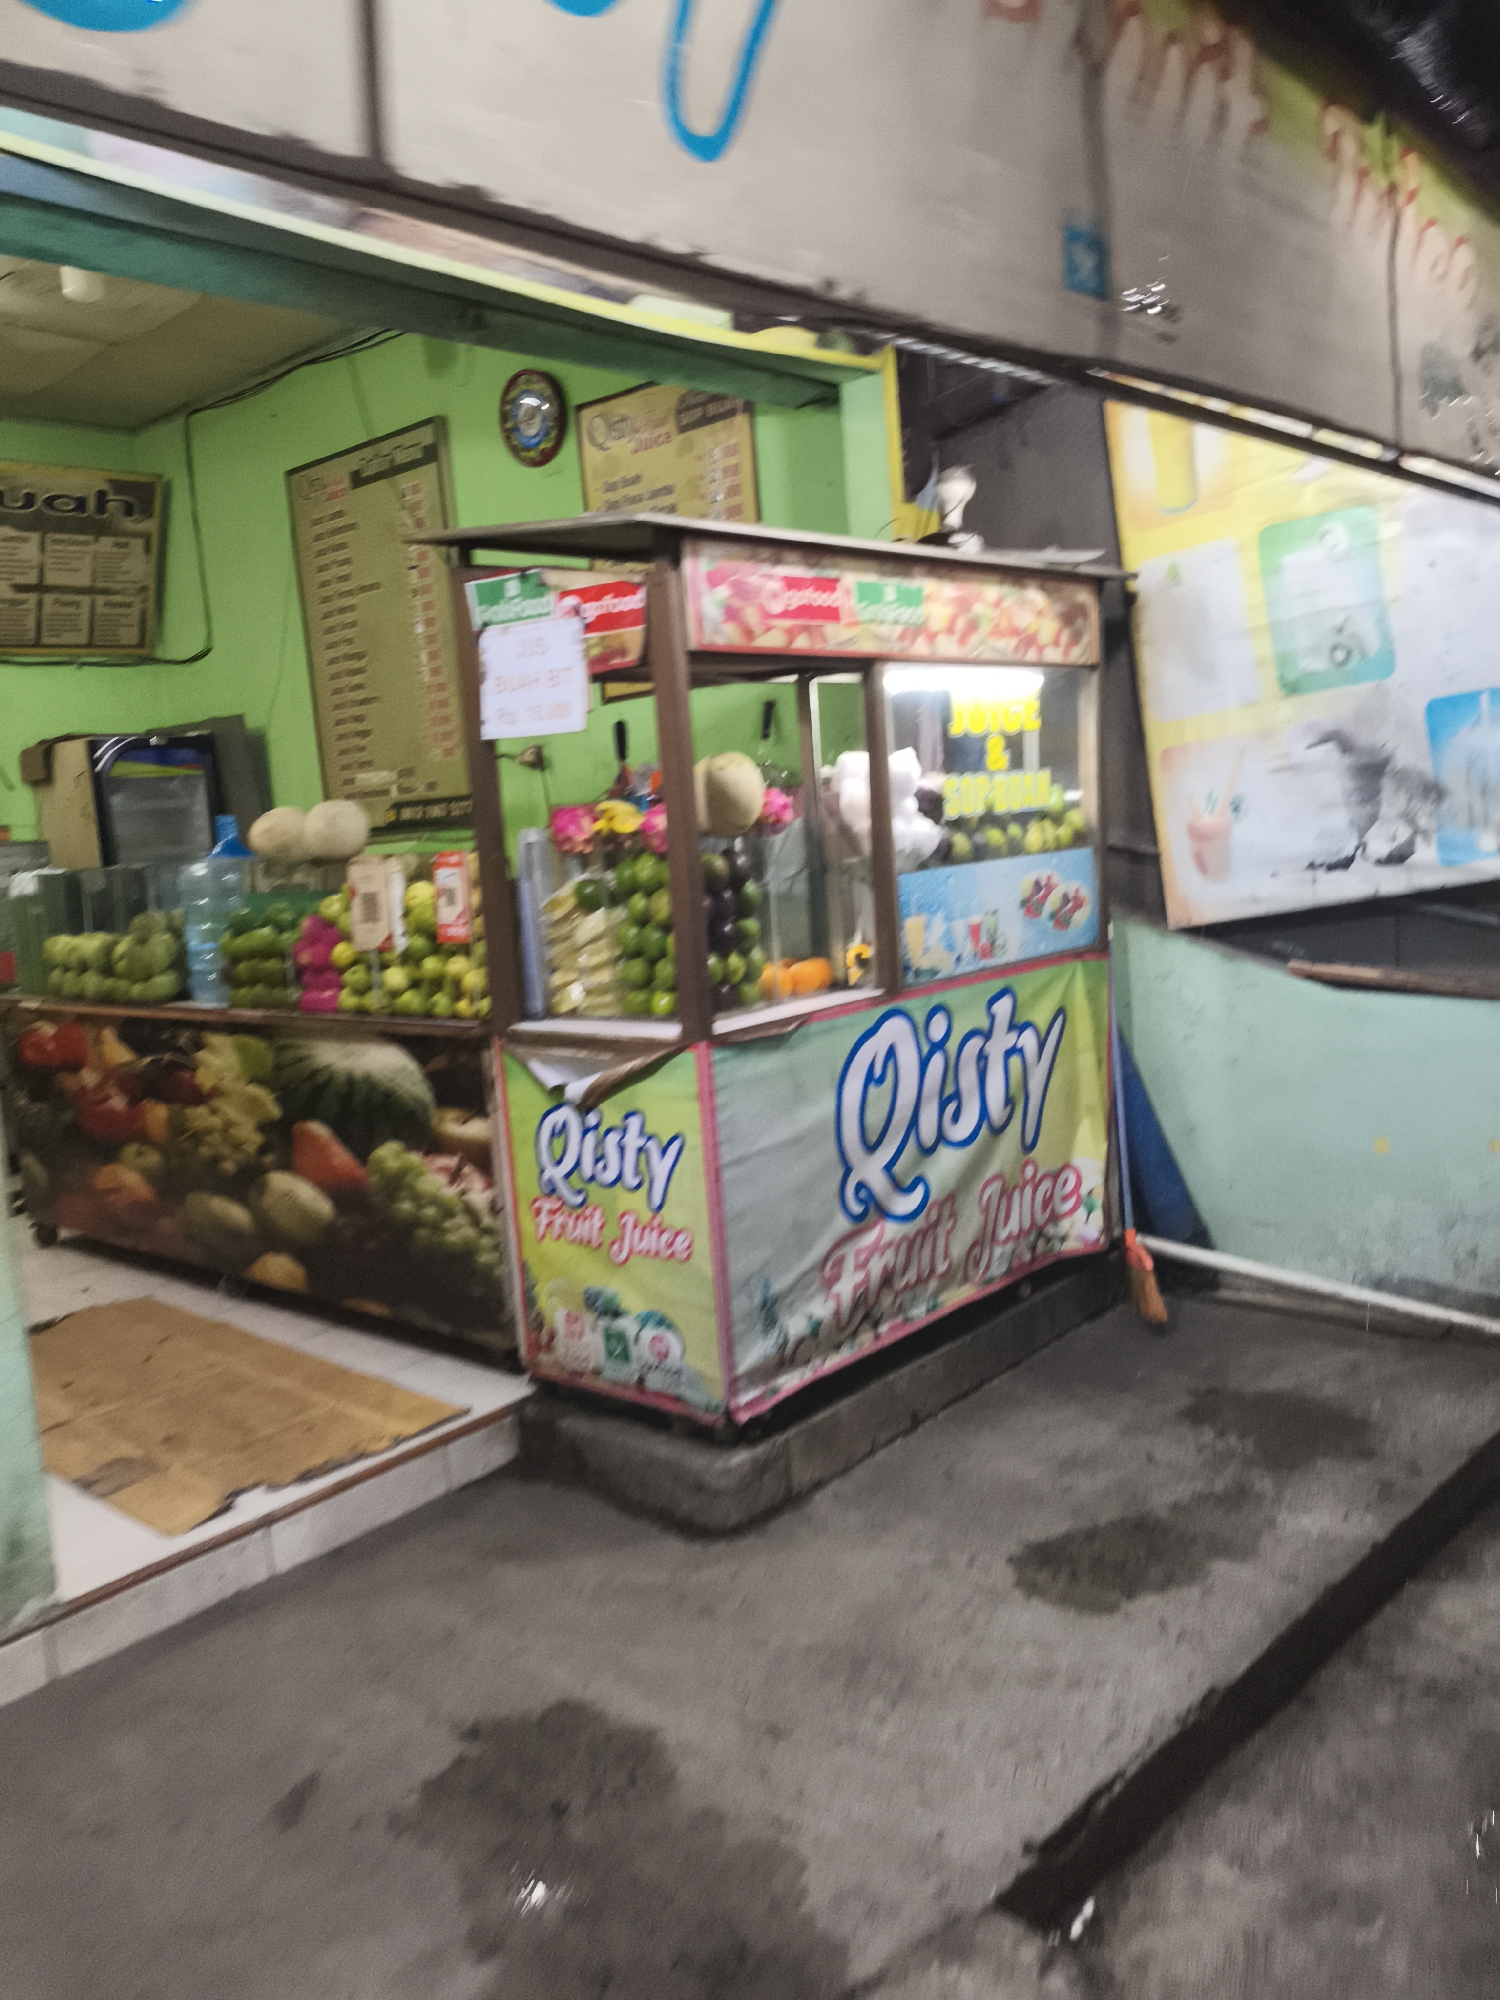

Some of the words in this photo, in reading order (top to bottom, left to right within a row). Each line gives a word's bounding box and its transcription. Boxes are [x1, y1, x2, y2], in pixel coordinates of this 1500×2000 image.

[948, 690, 1042, 737] JUICE
[984, 733, 1011, 772] &
[943, 772, 988, 821] SOP
[990, 769, 1052, 813] BUAH
[836, 985, 1067, 1225] Qisty
[536, 1102, 685, 1214] Qisty
[531, 1195, 606, 1250] Fruit
[609, 1208, 694, 1266] Juice
[820, 1193, 956, 1333] Fruit
[964, 1159, 1083, 1282] Juice
